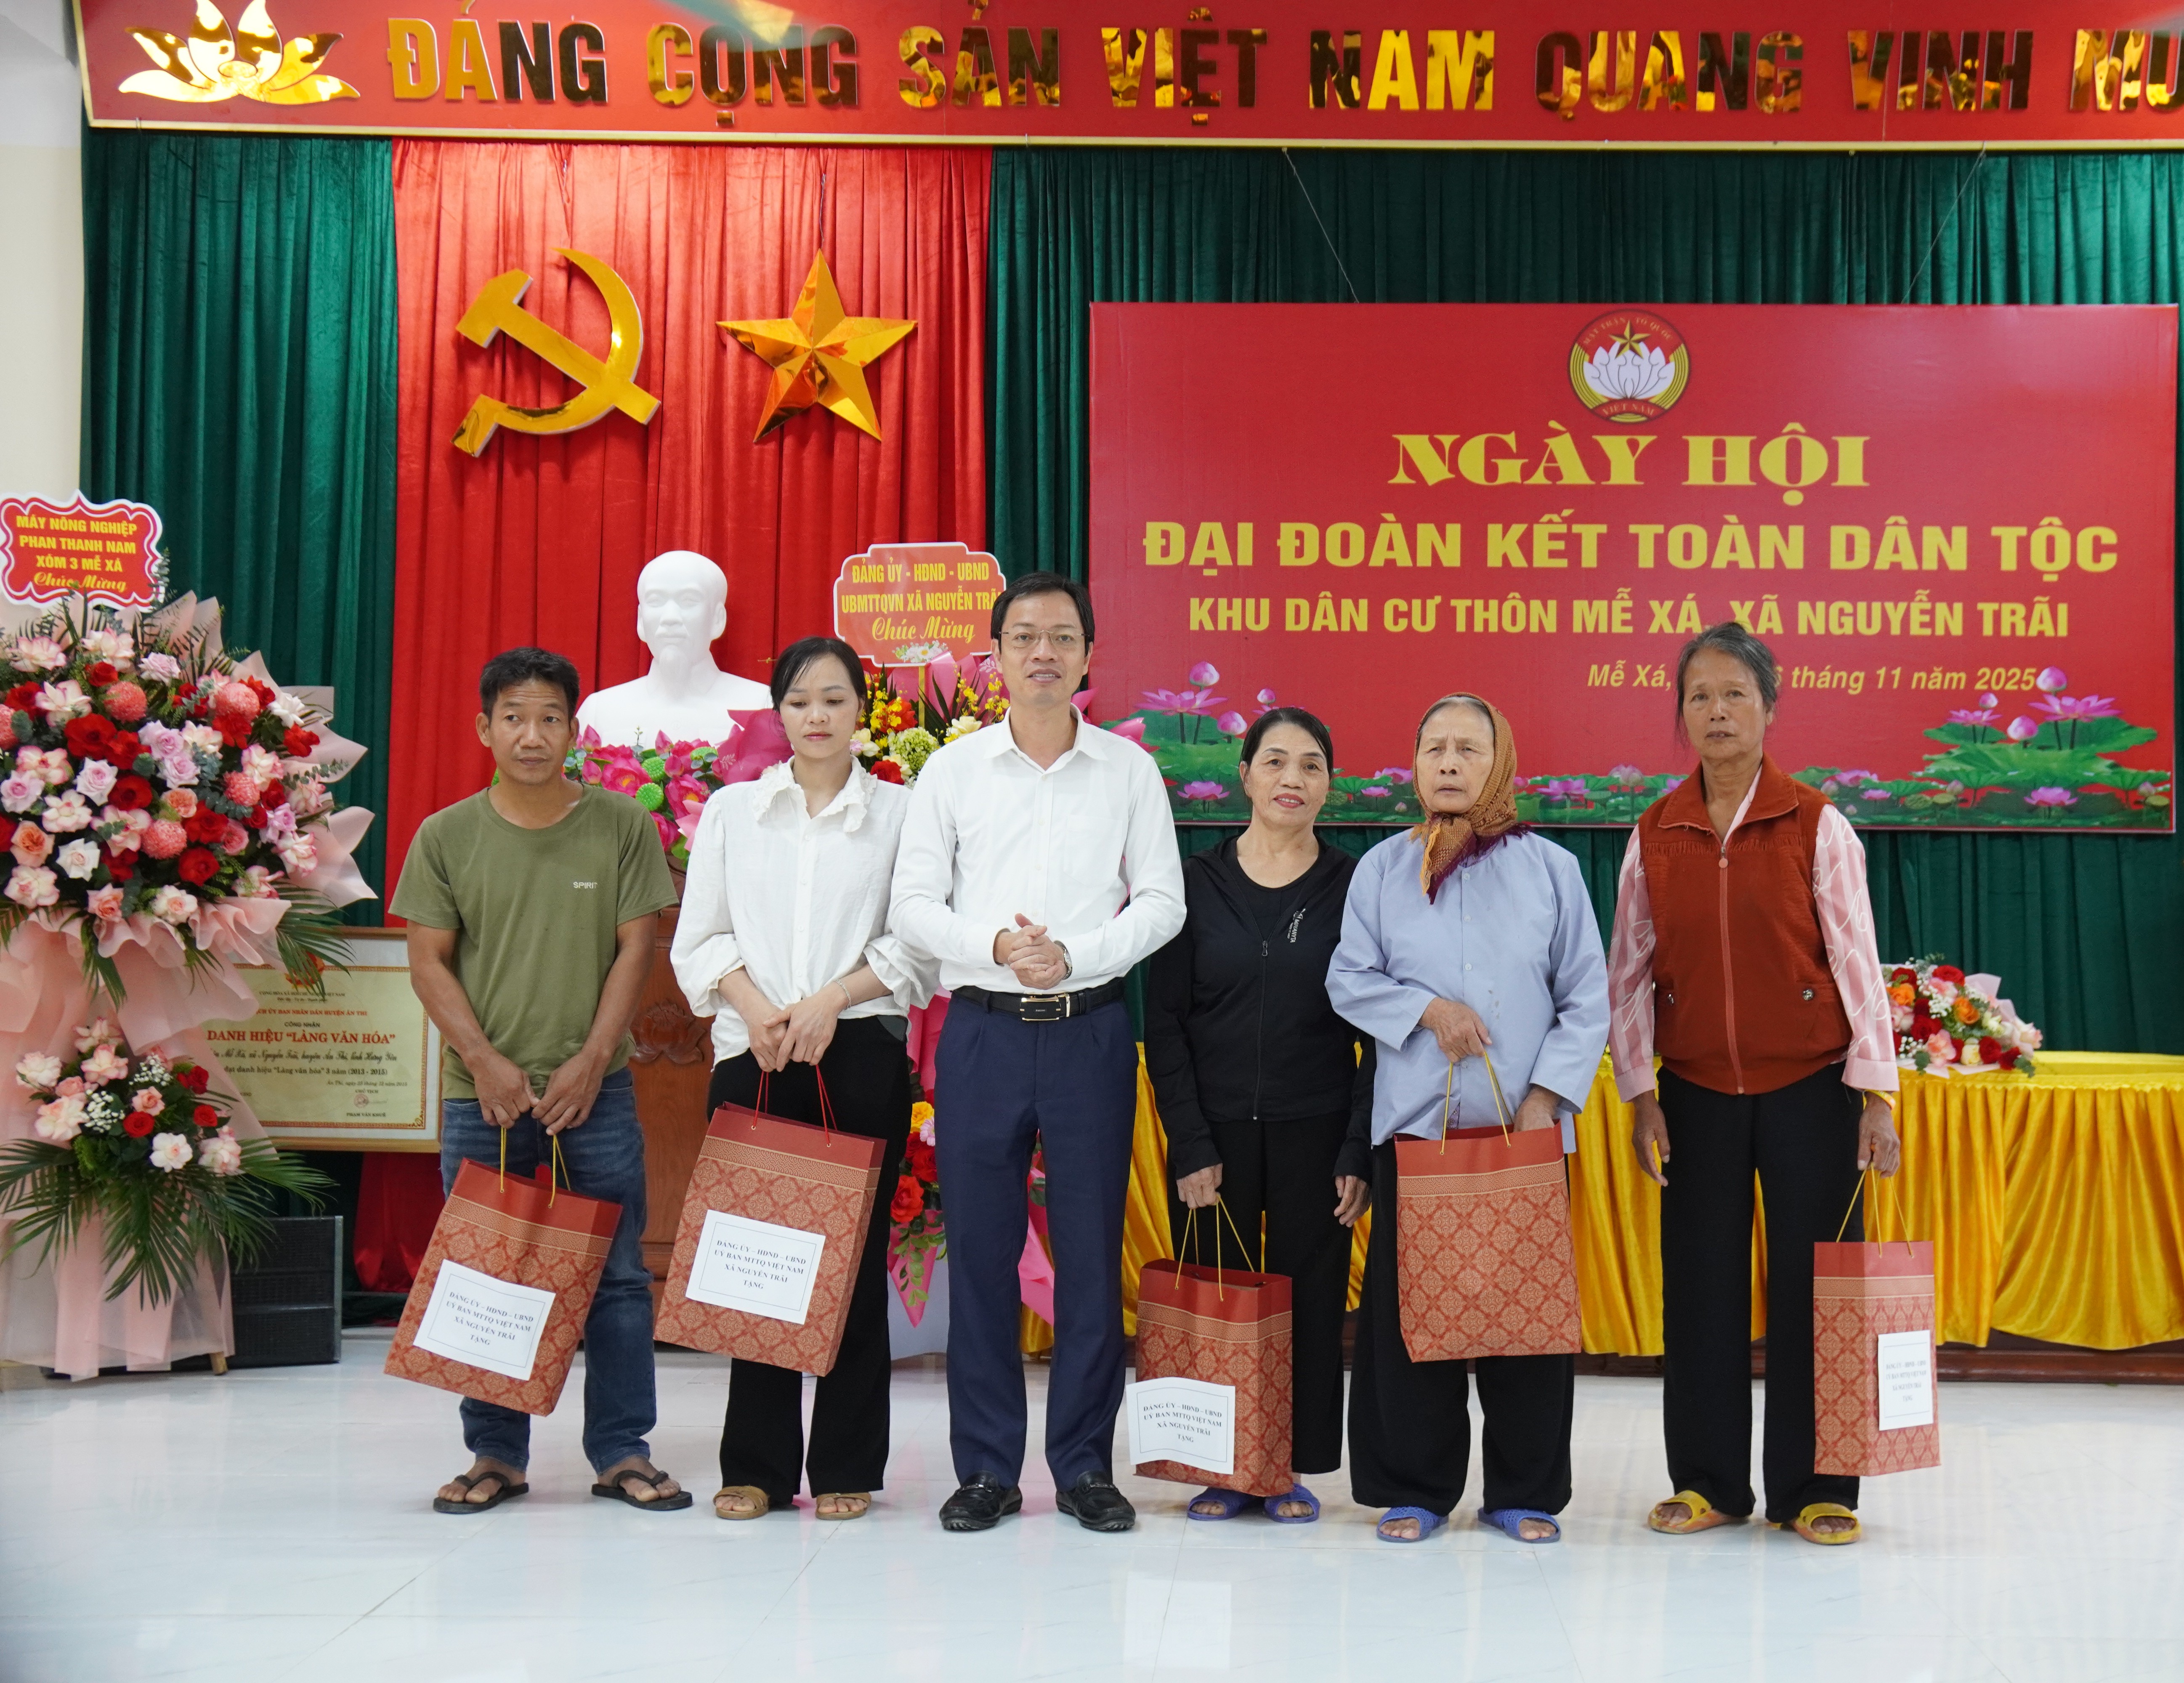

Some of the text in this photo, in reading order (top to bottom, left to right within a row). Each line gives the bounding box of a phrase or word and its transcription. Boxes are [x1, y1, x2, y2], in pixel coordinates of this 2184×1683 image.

[1100, 7, 1267, 126] VIỆT
[1309, 29, 1495, 110] NAM
[1535, 30, 1804, 121] QUANG
[1847, 30, 2034, 110] VINH
[1388, 420, 1870, 506] NGÀY HỘI
[90, 520, 137, 538] NGHIỆP
[19, 535, 136, 554] PHAN THANH NAM
[1143, 509, 2117, 581] ĐẠI ĐOÀN KẾT TOÀN DÂN TỘC
[70, 558, 78, 570] 3
[852, 557, 884, 583] ĐẢNG
[887, 557, 903, 583] ỦY
[914, 563, 946, 581] HĐND
[957, 562, 990, 581] UBND
[842, 585, 1001, 614] UBMTTQVN XÃ NGUYỄN TRÃ
[1190, 598, 1270, 631] KHU
[1286, 591, 1368, 632] DÂN
[1384, 596, 1441, 632] CƯ
[1451, 592, 1557, 633] THÔN
[1573, 588, 1633, 633] MỄ
[1730, 595, 1783, 634] XÃ
[1798, 590, 1963, 636] NGUYỄN
[1977, 597, 2068, 637] TRÃI
[872, 616, 976, 644] Chúc Mừng
[1588, 661, 1624, 686] Mễ
[1633, 665, 1672, 691] Xá,
[1791, 664, 1866, 695] tháng
[1875, 667, 1901, 689] 11
[1910, 666, 1966, 690] năm
[1975, 668, 2035, 690] 2025
[207, 1030, 246, 1041] DANH
[250, 1028, 283, 1044] HIỆU
[330, 1030, 358, 1043] VĂN
[744, 1256, 765, 1267] MTTQ
[768, 1261, 785, 1270] VIỆT
[786, 1266, 804, 1274] NAM
[757, 1249, 778, 1258] HĐND
[786, 1255, 806, 1265] UBND
[737, 1266, 768, 1278] NGUYỄN
[770, 1273, 788, 1283] TRÃI
[743, 1279, 764, 1290] TẶNG
[457, 1305, 472, 1315] BAN
[473, 1311, 494, 1324] MTTQ
[495, 1319, 513, 1329] VIỆT
[515, 1323, 531, 1332] NAM
[486, 1306, 507, 1317] HĐND
[514, 1313, 534, 1322] UBND
[454, 1316, 515, 1341] XÃ NGUYỄN TRÃI
[470, 1334, 491, 1346] TẶNG
[1172, 1412, 1190, 1420] MTTQ
[1182, 1404, 1199, 1412] HĐND
[1205, 1409, 1222, 1418] UBND
[1169, 1422, 1195, 1431] NGUYỄN
[1196, 1428, 1210, 1436] TRÃI
[1177, 1433, 1194, 1443] TẶNG
